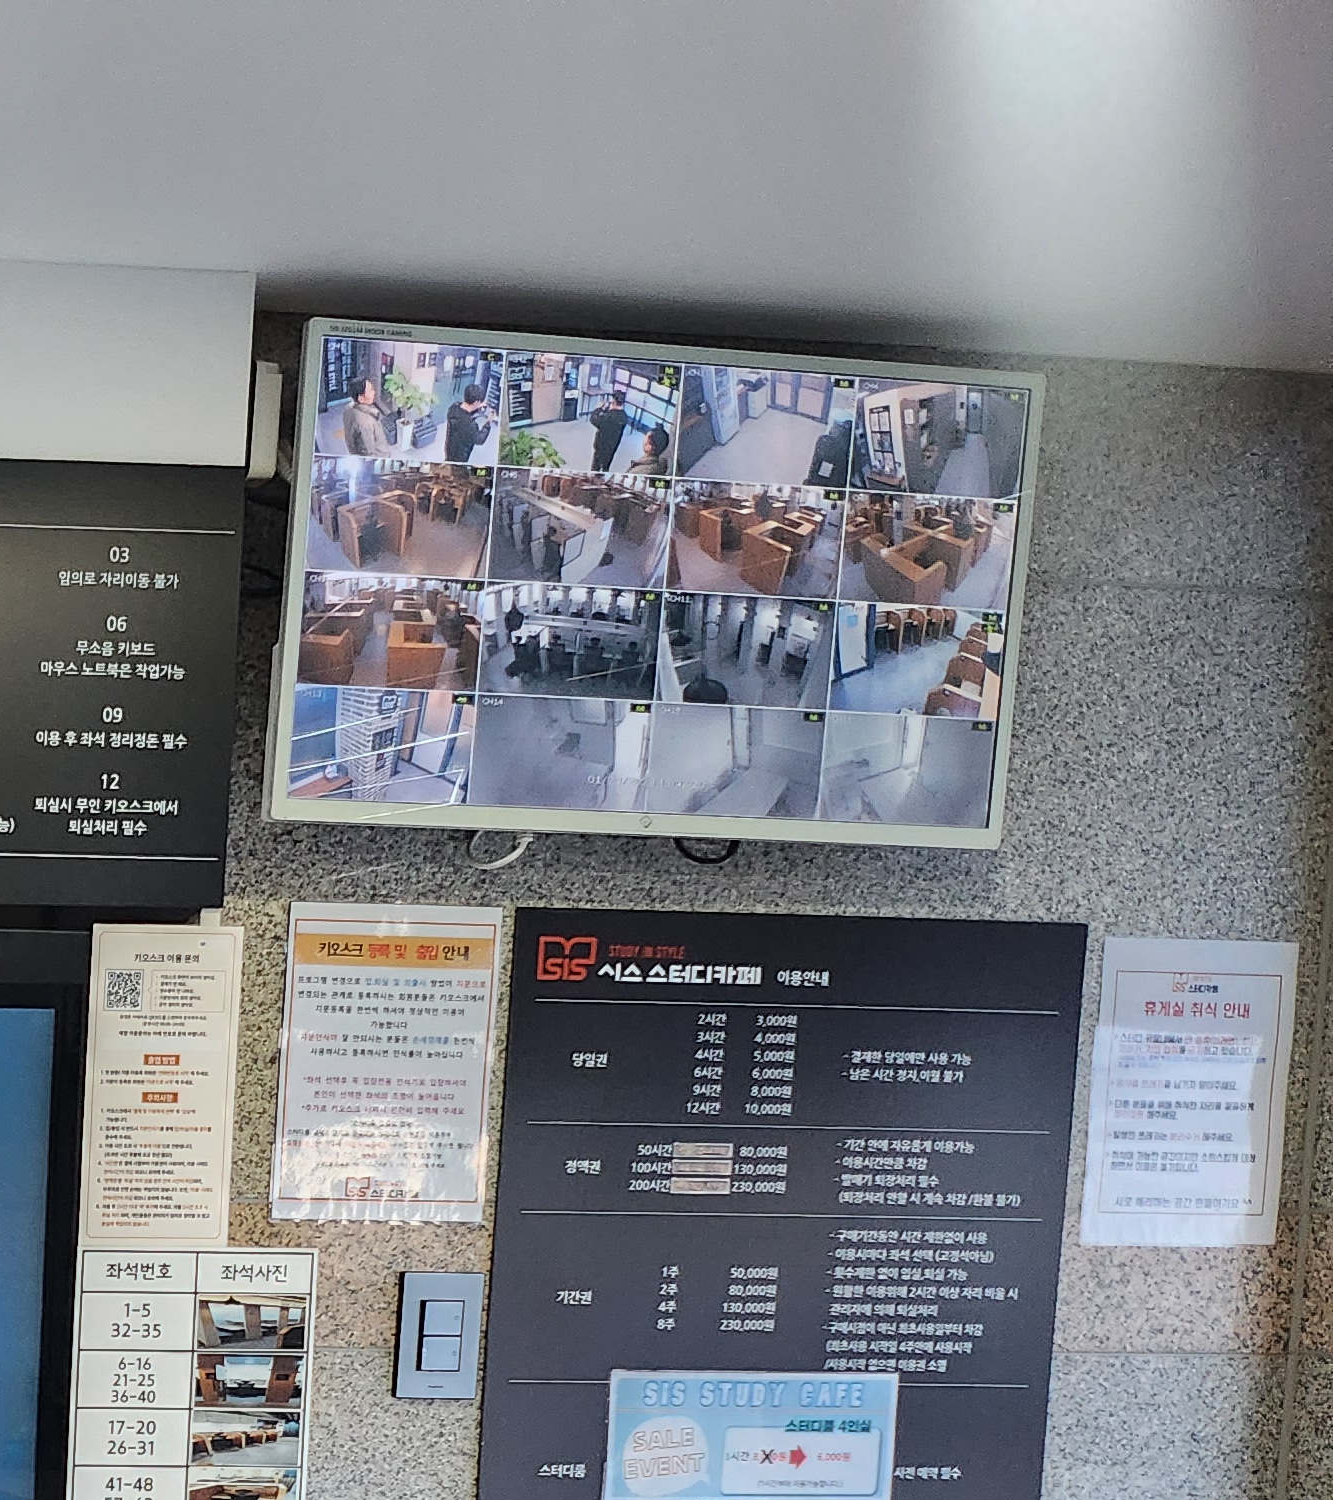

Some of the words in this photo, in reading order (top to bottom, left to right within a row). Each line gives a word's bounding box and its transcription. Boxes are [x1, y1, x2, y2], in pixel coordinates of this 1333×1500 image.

[109, 547, 130, 562] 03
[59, 571, 97, 586] 임의로
[99, 572, 150, 588] 자리이동
[153, 573, 179, 589] 불가
[106, 616, 127, 632] 06
[76, 640, 114, 656] 무소음
[117, 642, 155, 657] 키보드
[41, 661, 79, 676] 마우스
[81, 662, 132, 678] 노트북은
[135, 664, 185, 680] 작업가능
[134, 954, 165, 963] 키오스크
[167, 954, 182, 963] 이용
[184, 954, 200, 963] 문의
[319, 942, 363, 957] 키오스크
[395, 945, 406, 959] 및
[443, 946, 470, 961] 안내
[597, 962, 643, 982] 시스
[645, 964, 761, 984] 스터디카페
[777, 969, 829, 987] 이용안내
[1144, 1001, 1184, 1017] 휴게실
[1191, 1002, 1217, 1017] 취식
[1223, 1003, 1251, 1019] 안내
[697, 1013, 727, 1026] 2시간
[756, 1014, 797, 1028] 3,000원
[696, 1031, 727, 1044] 3시간
[753, 1032, 796, 1046] 4,000원
[571, 1052, 609, 1068] 당일권
[694, 1049, 725, 1062] 4시간
[753, 1050, 795, 1064] 5,000원
[693, 1067, 723, 1080] 6시간
[752, 1068, 793, 1081] 6,000원
[693, 1085, 722, 1098] 9시간
[751, 1086, 792, 1099] 8,000원
[687, 1102, 721, 1115] 12시간
[745, 1103, 792, 1116] 10,000원
[565, 1160, 601, 1174] 정액권
[105, 1262, 173, 1280] 좌석번호
[221, 1264, 288, 1283] 좌석사진
[556, 1290, 592, 1306] 기간권
[123, 1303, 152, 1318] 1-5
[110, 1323, 161, 1339] 32-35
[117, 1357, 152, 1370] 6-16
[113, 1374, 155, 1387] 21-25
[110, 1390, 156, 1403] 36-40
[644, 1381, 687, 1407] SIS
[700, 1381, 786, 1407] STUDY
[108, 1421, 156, 1435] 17-20
[633, 1427, 694, 1452] SALE
[106, 1440, 155, 1456] 26-31
[624, 1453, 704, 1480] EVENT
[104, 1478, 154, 1492] 41-48
